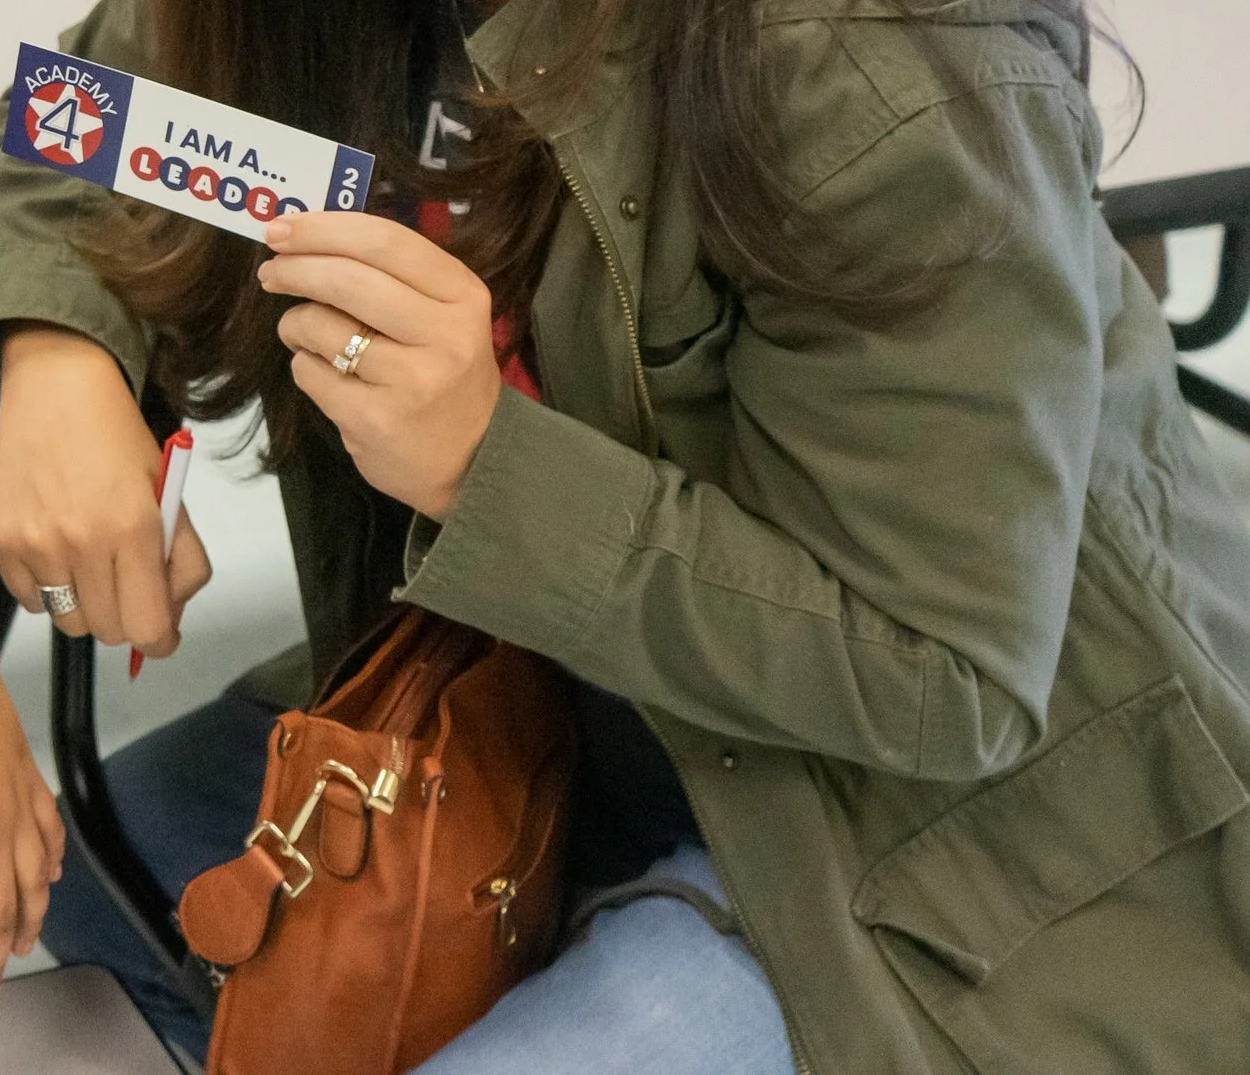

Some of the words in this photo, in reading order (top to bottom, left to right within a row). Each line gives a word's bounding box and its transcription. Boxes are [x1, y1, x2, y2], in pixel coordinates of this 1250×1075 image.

[24, 64, 118, 115] ACADEMY
[37, 97, 81, 150] 4
[164, 120, 175, 144] I
[179, 128, 233, 164] AM
[237, 148, 287, 183] A...
[337, 167, 360, 210] 20
